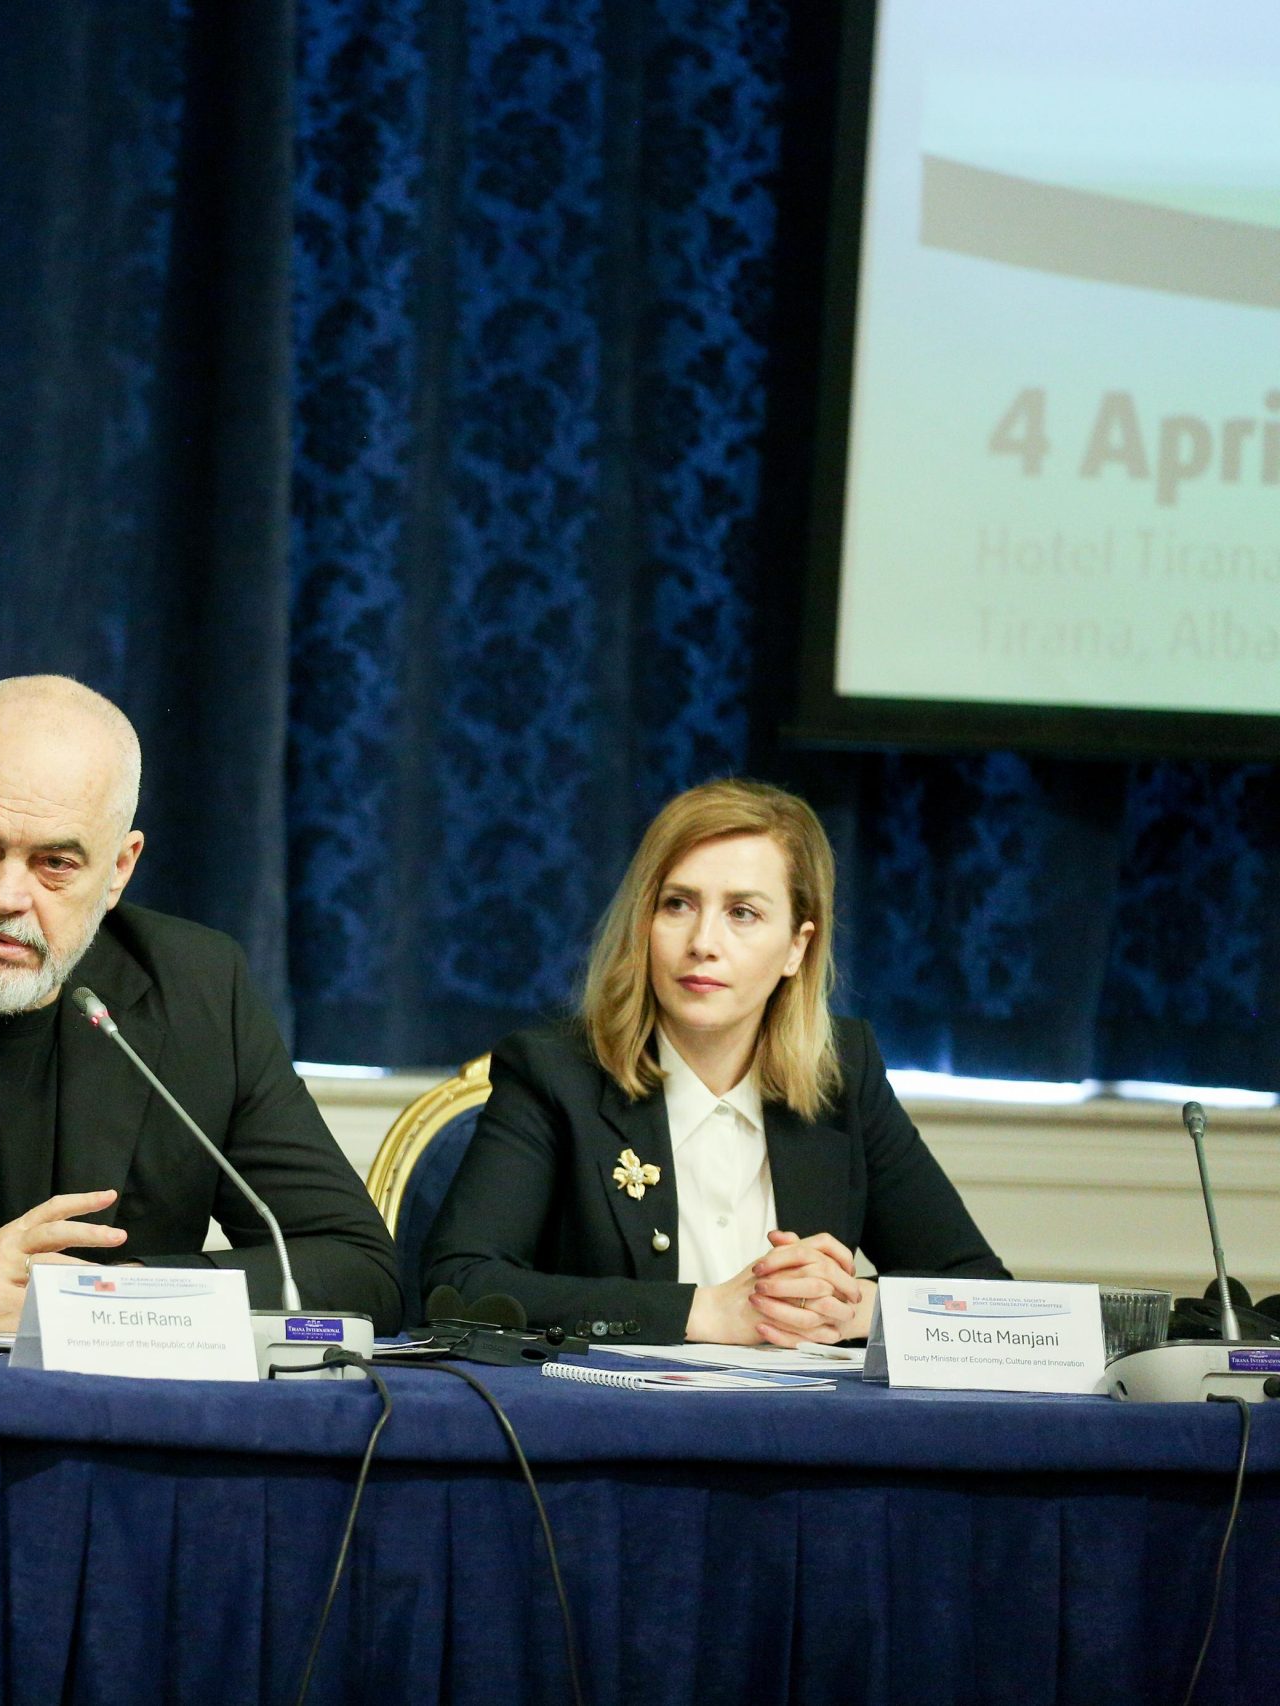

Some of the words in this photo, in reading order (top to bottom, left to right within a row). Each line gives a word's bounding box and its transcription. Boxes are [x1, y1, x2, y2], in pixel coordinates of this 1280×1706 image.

[987, 387, 1051, 480] 4
[975, 521, 1114, 578] Hotel
[91, 1310, 116, 1325] Mr.
[119, 1310, 144, 1326] Edi
[147, 1311, 192, 1327] Rama
[67, 1338, 91, 1347] Prime
[92, 1338, 126, 1348] Minister
[126, 1338, 136, 1348] of
[136, 1339, 150, 1349] the
[187, 1340, 196, 1349] of
[925, 1327, 954, 1342] Ms.
[958, 1328, 993, 1344] Olta
[996, 1330, 1060, 1349] Manjani
[904, 1353, 930, 1363] Deputy
[930, 1354, 960, 1363] Minister
[960, 1355, 969, 1363] of
[969, 1355, 1004, 1365] Economy,
[1005, 1356, 1032, 1366] Culture
[1033, 1358, 1046, 1367] and
[1047, 1358, 1085, 1368] Innovation
